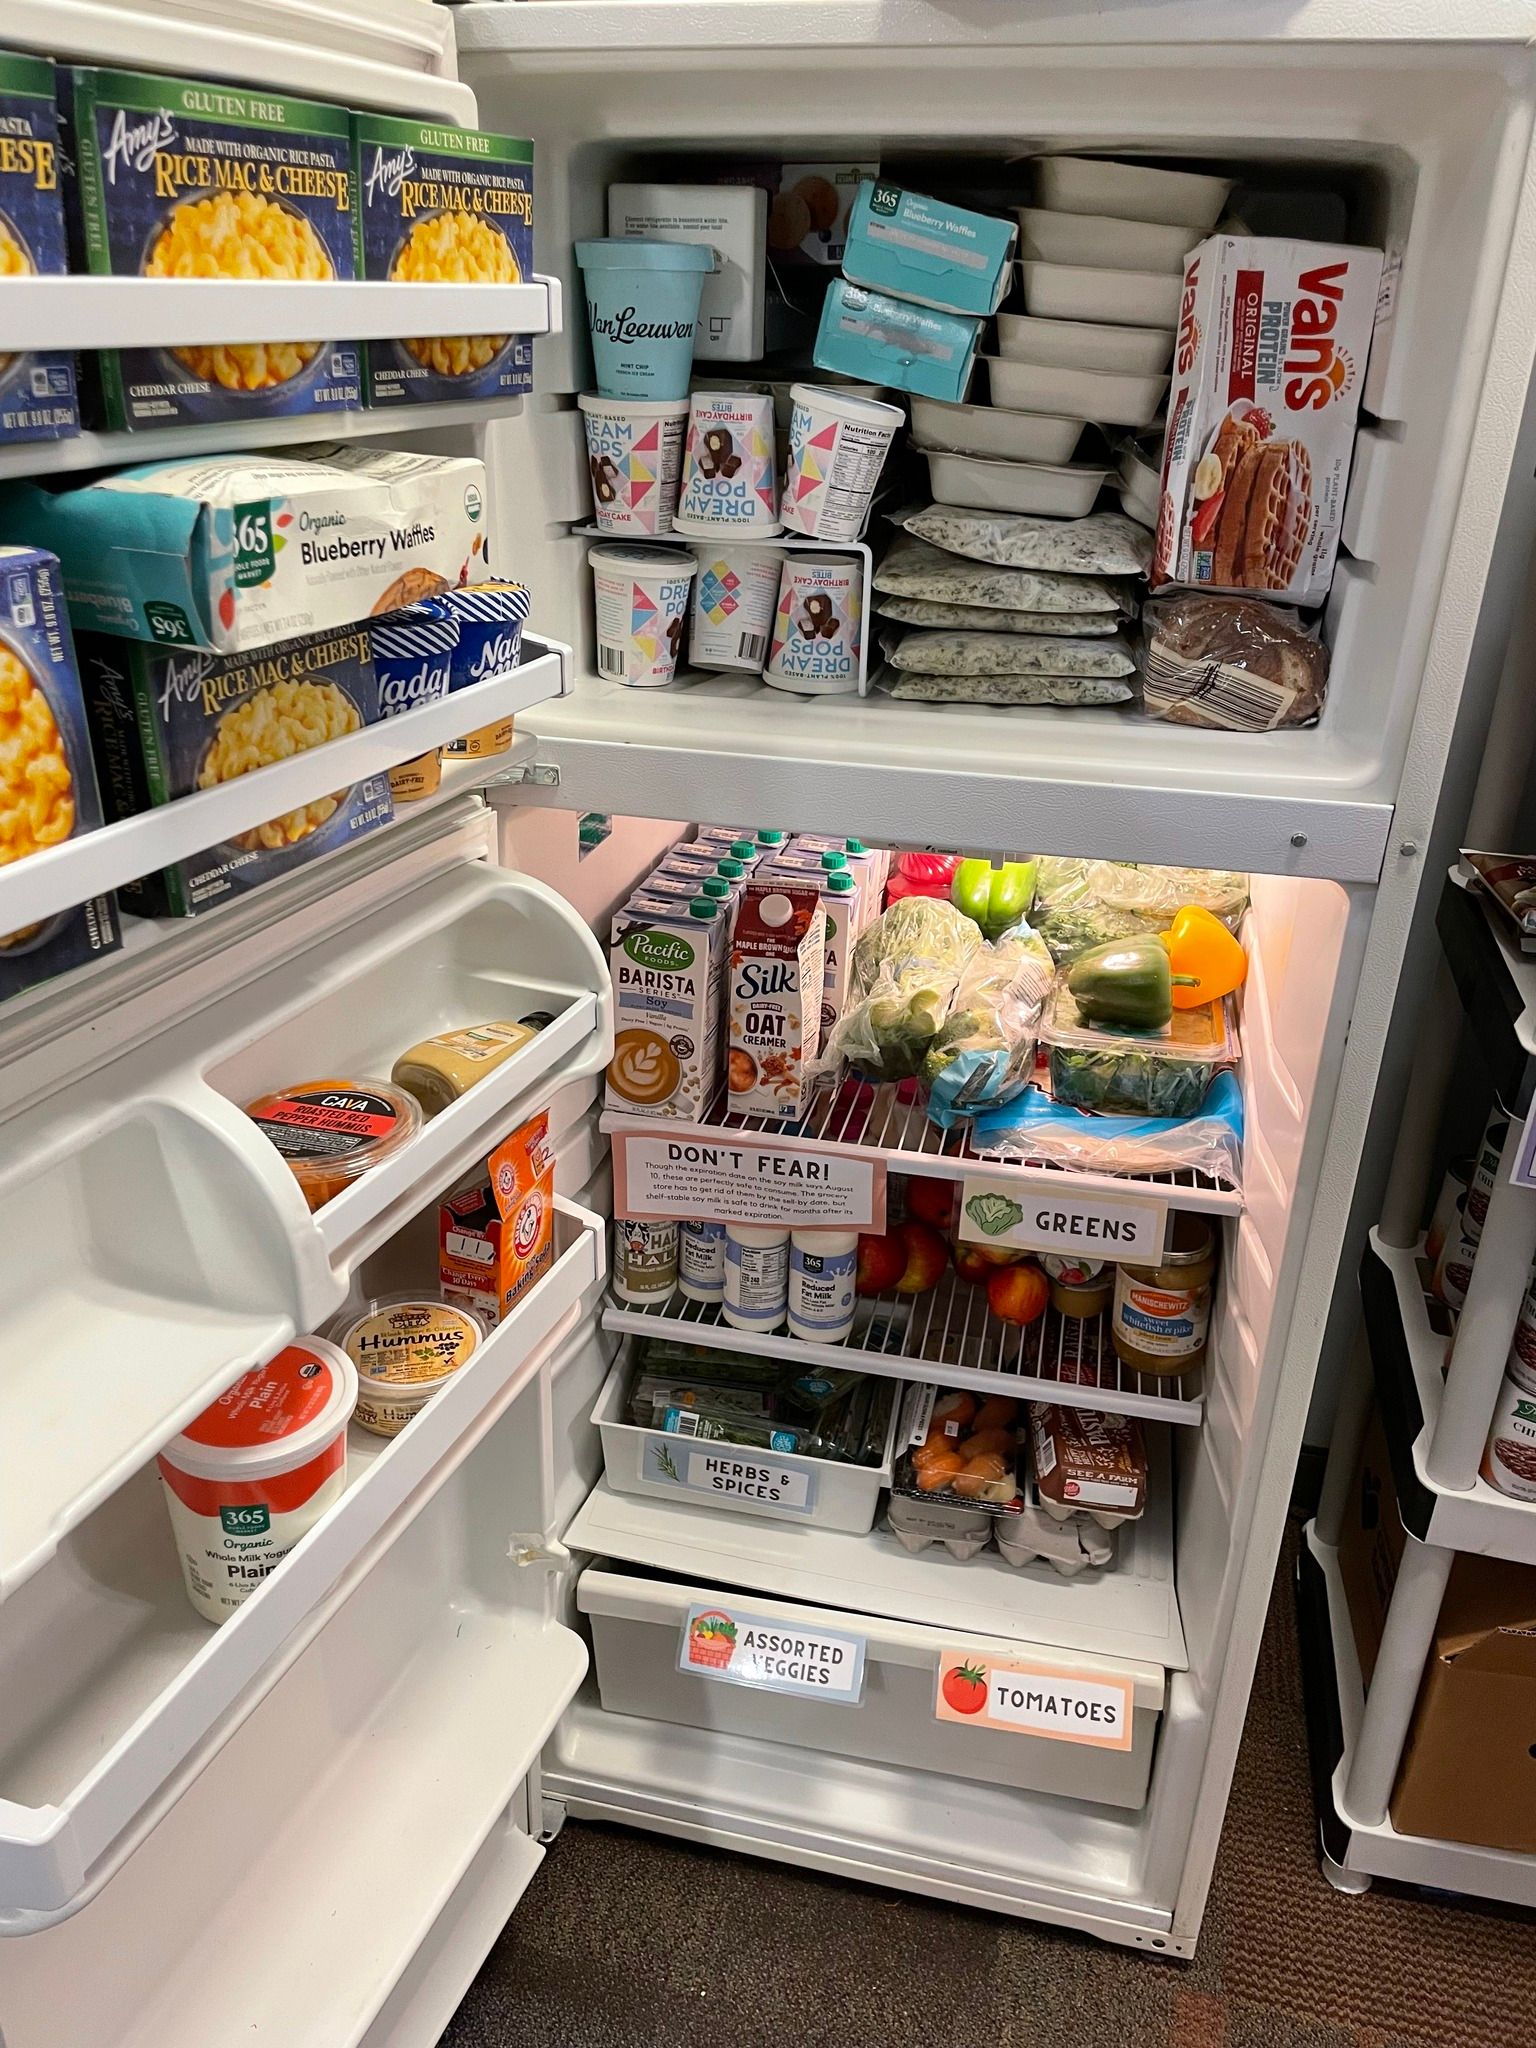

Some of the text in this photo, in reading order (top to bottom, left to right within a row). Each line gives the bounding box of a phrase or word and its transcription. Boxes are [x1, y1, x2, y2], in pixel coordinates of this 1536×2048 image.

[183, 90, 285, 122] GLUTEN FREE
[104, 107, 178, 185] Amy's
[420, 129, 490, 153] GLUTEN FREE
[185, 137, 335, 168] MADE WITH ORGANIC RICE PASTA
[155, 152, 349, 211] RICE MAC & CHEESE
[365, 144, 417, 207] Amy's
[421, 167, 524, 191] MADE WITH ORGANIC PASTA
[401, 180, 532, 226] RICE MAC & CHEESE
[874, 190, 898, 208] 365
[903, 208, 944, 229] Blueberry
[946, 221, 977, 238] Waffles
[587, 300, 693, 344] Van Leeuwen
[872, 303, 942, 331] Blueberry Waffles
[1241, 292, 1259, 379] ORIGINAL
[1280, 301, 1291, 356] POWER GRAINS
[1257, 301, 1283, 384] PROTEIN
[374, 368, 429, 381] CHEDDAR CHEESE
[129, 382, 211, 397] CHEDDAR CHEESE
[711, 403, 732, 412] BITES
[712, 411, 753, 422] BIRTHDAY
[585, 418, 632, 440] REAM
[844, 424, 877, 438] Nutrition
[590, 440, 623, 458] OPS
[692, 477, 746, 498] POPS
[1330, 473, 1341, 521] PLANT-BASED
[685, 495, 755, 517] DREAM
[299, 511, 347, 535] Organic
[611, 513, 632, 521] CAKE
[1308, 520, 1318, 545] serving
[301, 523, 435, 566] Blueberry Waffles
[811, 577, 849, 586] BIRTHDAY
[812, 571, 832, 579] BITES
[152, 616, 190, 638] 365
[275, 636, 313, 655] ORGANIC
[791, 638, 843, 654] POPS
[781, 653, 850, 673] DREAM
[200, 631, 371, 716] RICE MAC & CHEESE
[137, 691, 155, 750] GLUTEN
[188, 851, 260, 888] CHEDDAR CHEESE
[631, 934, 689, 960] Pacific
[736, 940, 784, 952] MAPLE BROWN
[644, 956, 675, 966] FOODS
[619, 967, 695, 996] BARISTA
[736, 963, 799, 999] Silk
[639, 987, 678, 999] SERIES
[646, 996, 667, 1009] Soy
[646, 1012, 667, 1021] Vanilla
[746, 1013, 786, 1036] OAT
[743, 1035, 786, 1048] CREAMER
[321, 1095, 369, 1111] CAVA
[272, 1111, 372, 1132] PEPPER HUMMUS
[293, 1105, 371, 1123] ROASTED RED
[645, 1162, 673, 1171] Though
[690, 1167, 727, 1177] expiration
[729, 1172, 746, 1180] date
[668, 1143, 829, 1181] DON'T FEAR!
[663, 1173, 683, 1181] these
[700, 1177, 734, 1187] perfectly
[764, 1187, 799, 1196] consume.
[818, 1192, 848, 1200] grocery
[646, 1193, 690, 1201] shelf-stable
[760, 1202, 778, 1210] drink
[736, 1190, 754, 1198] them
[783, 1198, 808, 1206] sell-by
[714, 1208, 783, 1220] marked expiration.
[453, 1226, 474, 1238] Change
[1035, 1210, 1137, 1242] GREENS
[651, 1228, 678, 1249] HAL
[685, 1240, 716, 1254] Reduced
[696, 1251, 713, 1261] Milk
[804, 1257, 821, 1268] 365
[443, 1267, 466, 1278] Change
[463, 1279, 477, 1287] Days
[505, 1267, 534, 1303] Baking
[802, 1280, 836, 1292] Reduced
[802, 1288, 832, 1300] Fat Milk
[1132, 1292, 1188, 1310] MANISCHEWITZ
[1143, 1316, 1169, 1326] sweet
[357, 1331, 464, 1351] Hummus
[249, 1381, 278, 1409] Plain
[706, 1458, 790, 1486] HERBS &
[1066, 1468, 1094, 1478] SEE
[712, 1476, 781, 1501] SPICES
[226, 1510, 264, 1526] 365
[223, 1538, 274, 1552] Organic
[205, 1550, 236, 1562] Whole
[743, 1630, 844, 1665] ASSORTED
[997, 1686, 1117, 1724] TOMATOES
